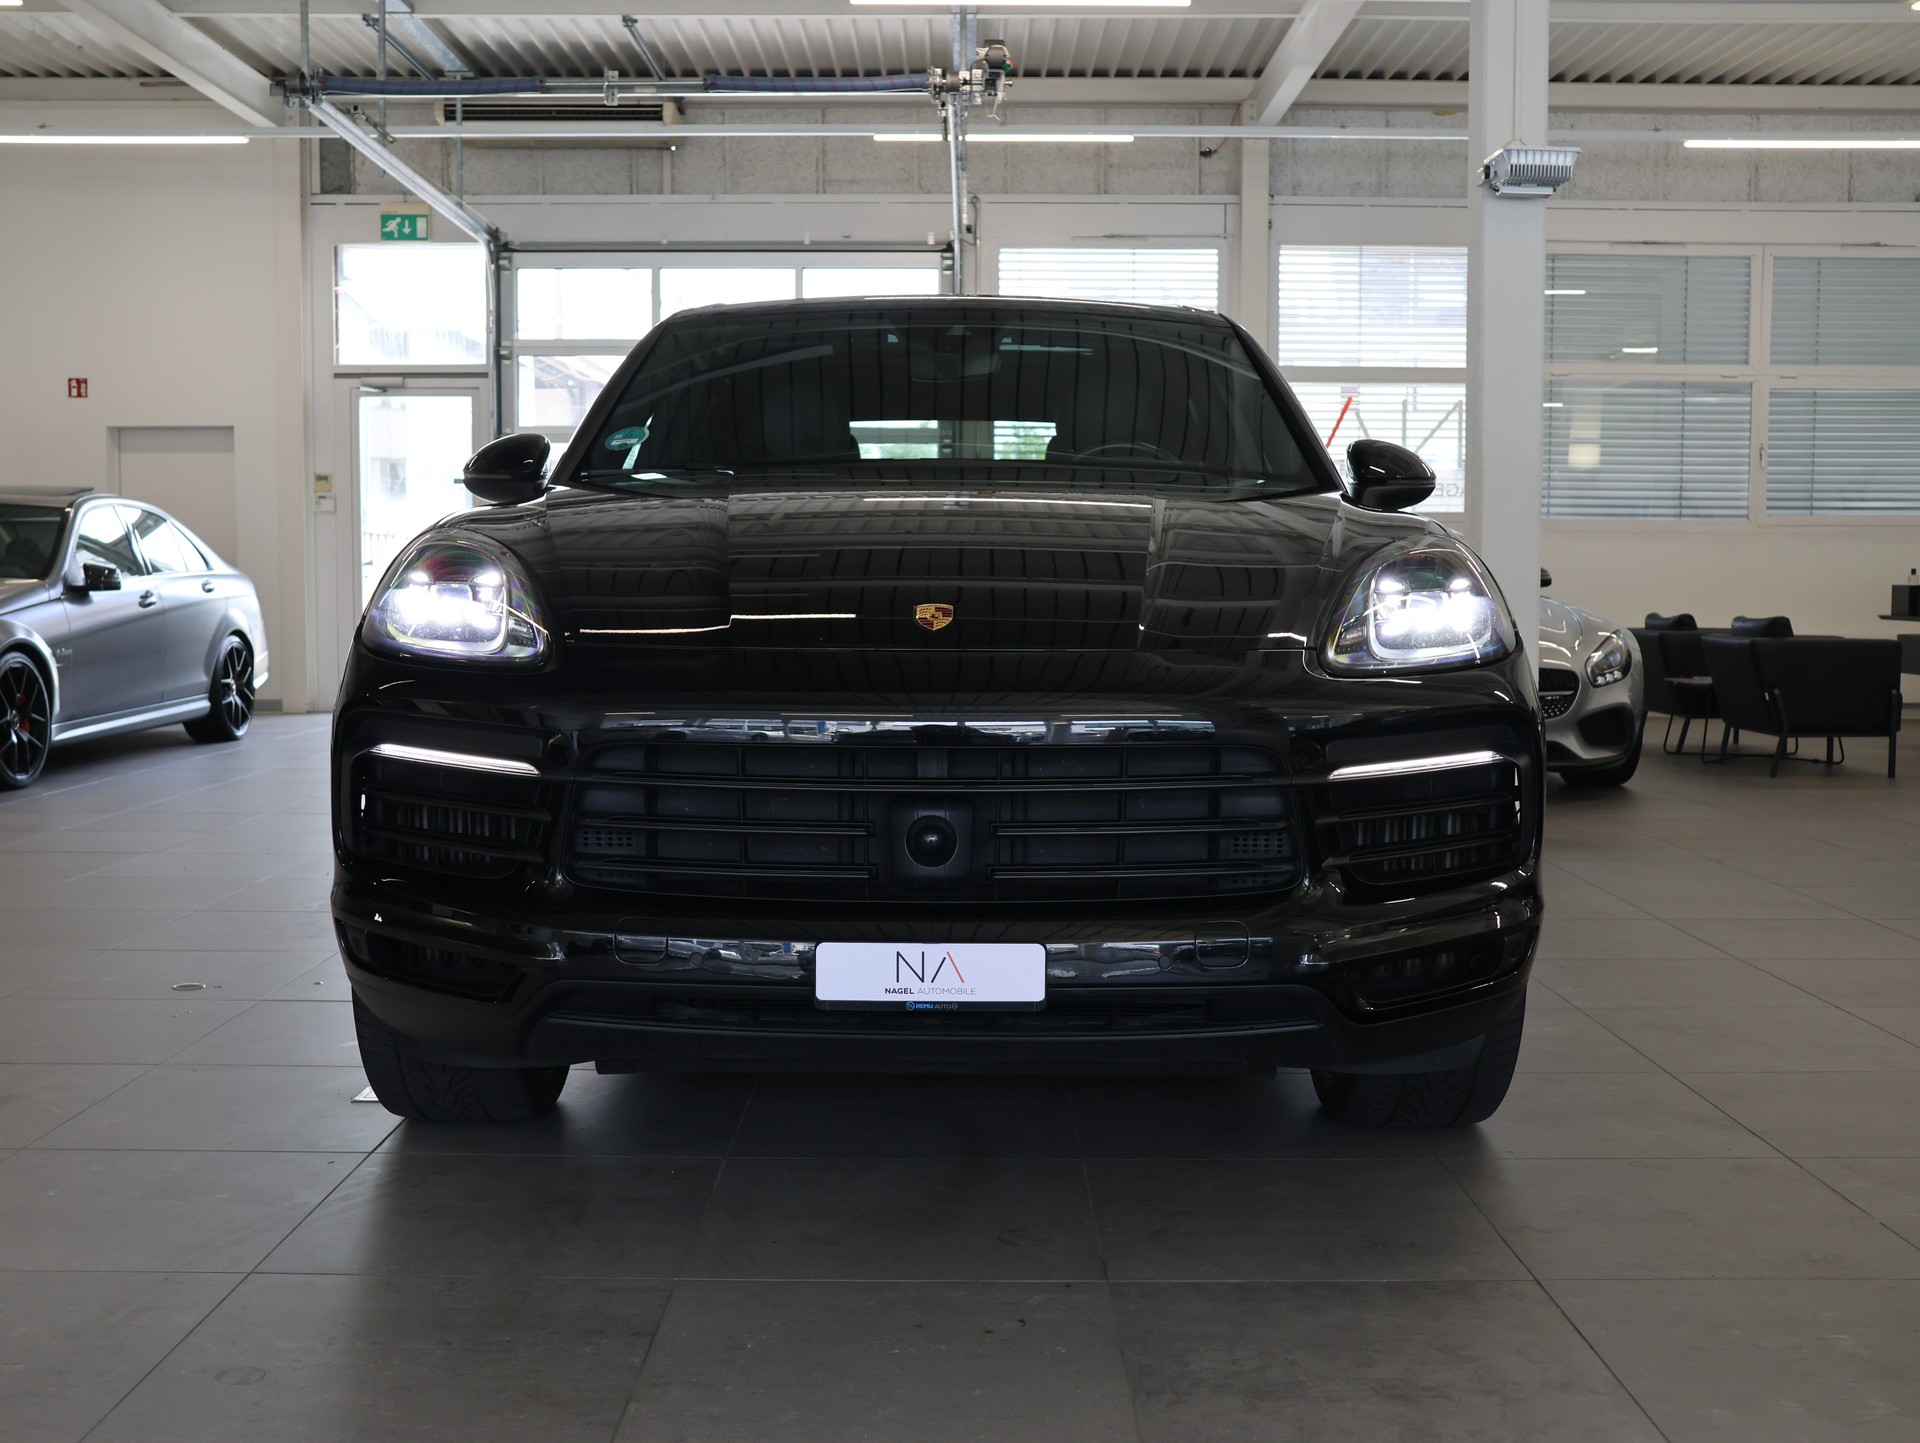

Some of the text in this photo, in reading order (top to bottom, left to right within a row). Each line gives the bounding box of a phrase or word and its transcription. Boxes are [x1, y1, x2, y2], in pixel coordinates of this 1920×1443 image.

[896, 951, 965, 983] NA
[884, 987, 976, 996] NAGEL AUTOMOBILE
